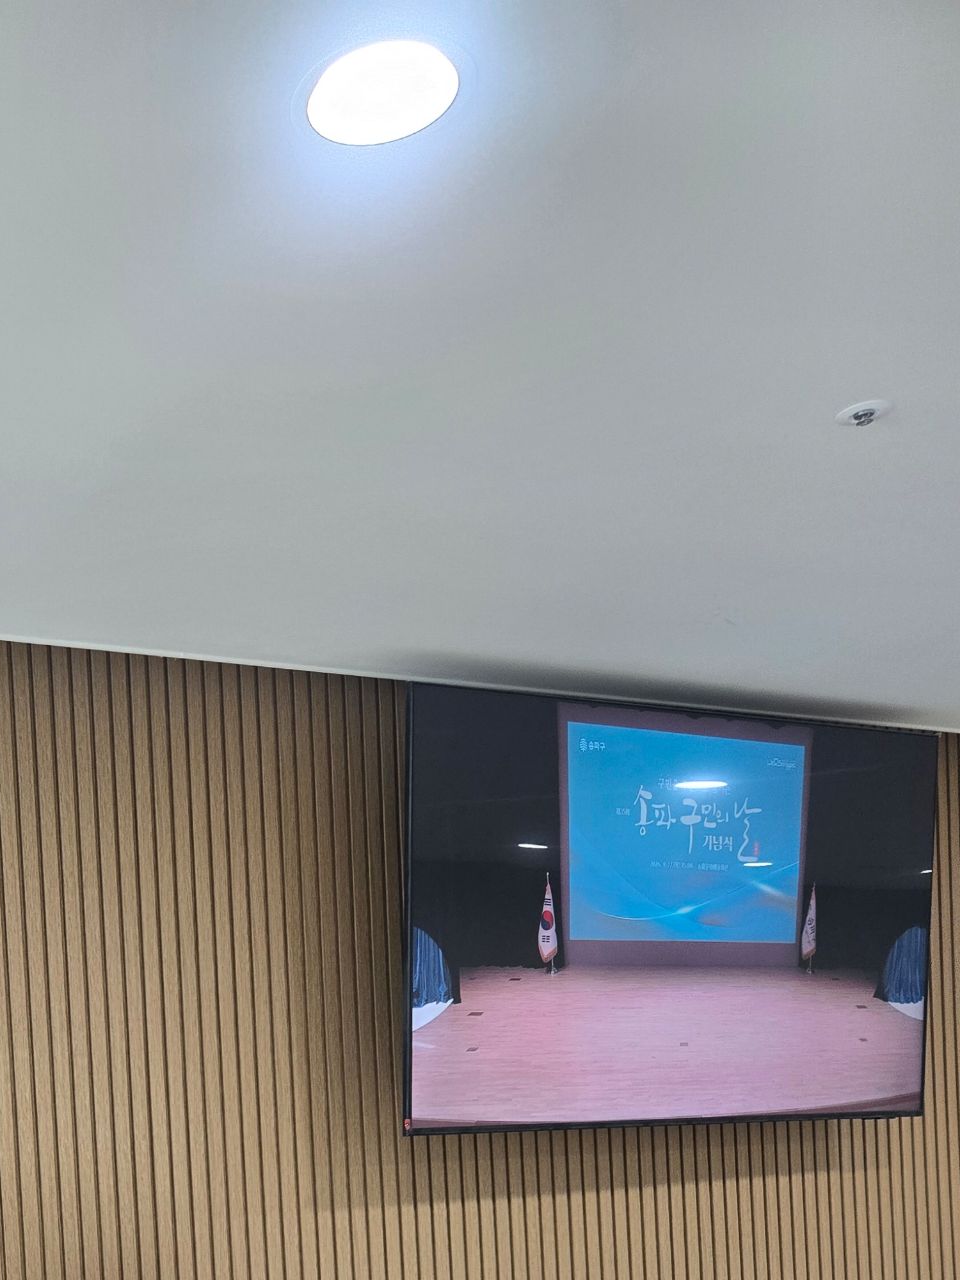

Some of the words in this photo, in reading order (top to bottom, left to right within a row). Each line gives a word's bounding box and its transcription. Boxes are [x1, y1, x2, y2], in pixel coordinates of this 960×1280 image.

[634, 785, 676, 836] 송파
[680, 798, 730, 854] 구민의
[734, 797, 762, 862] 날
[702, 835, 733, 852] 기념식
